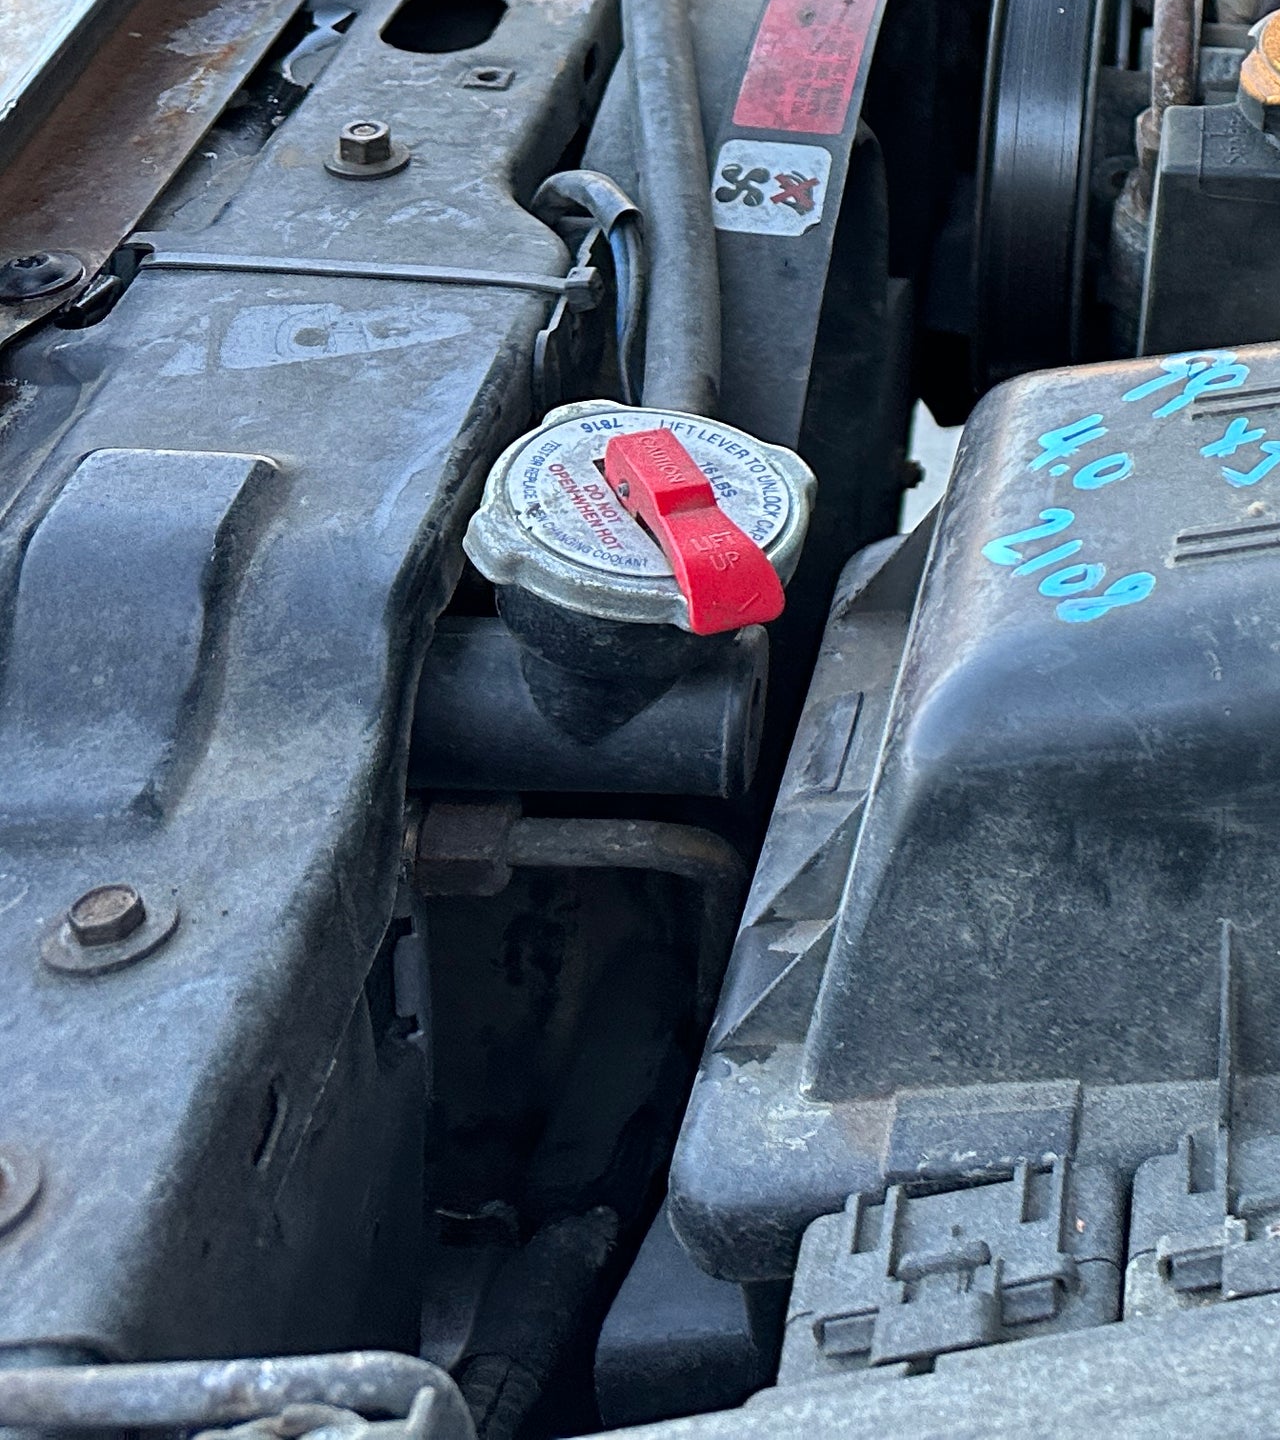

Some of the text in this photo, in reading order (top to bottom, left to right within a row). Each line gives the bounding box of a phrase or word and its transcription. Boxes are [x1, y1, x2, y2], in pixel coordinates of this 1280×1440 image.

[580, 417, 624, 433] 7816
[640, 436, 687, 484] CAUTION
[698, 429, 750, 459] LEVER
[1029, 413, 1135, 490] 4.0
[700, 461, 738, 498] 16 LBS
[745, 457, 766, 474] TO
[523, 440, 648, 567] TEST OR REPLACE EN CHANGING COOLANT
[583, 483, 623, 523] DO NOT
[757, 475, 782, 519] UNLOCK
[595, 527, 624, 550] HOT
[690, 530, 735, 552] LIFT
[749, 519, 776, 541] CAP
[709, 552, 740, 572] UP
[981, 508, 1156, 623] 2108
